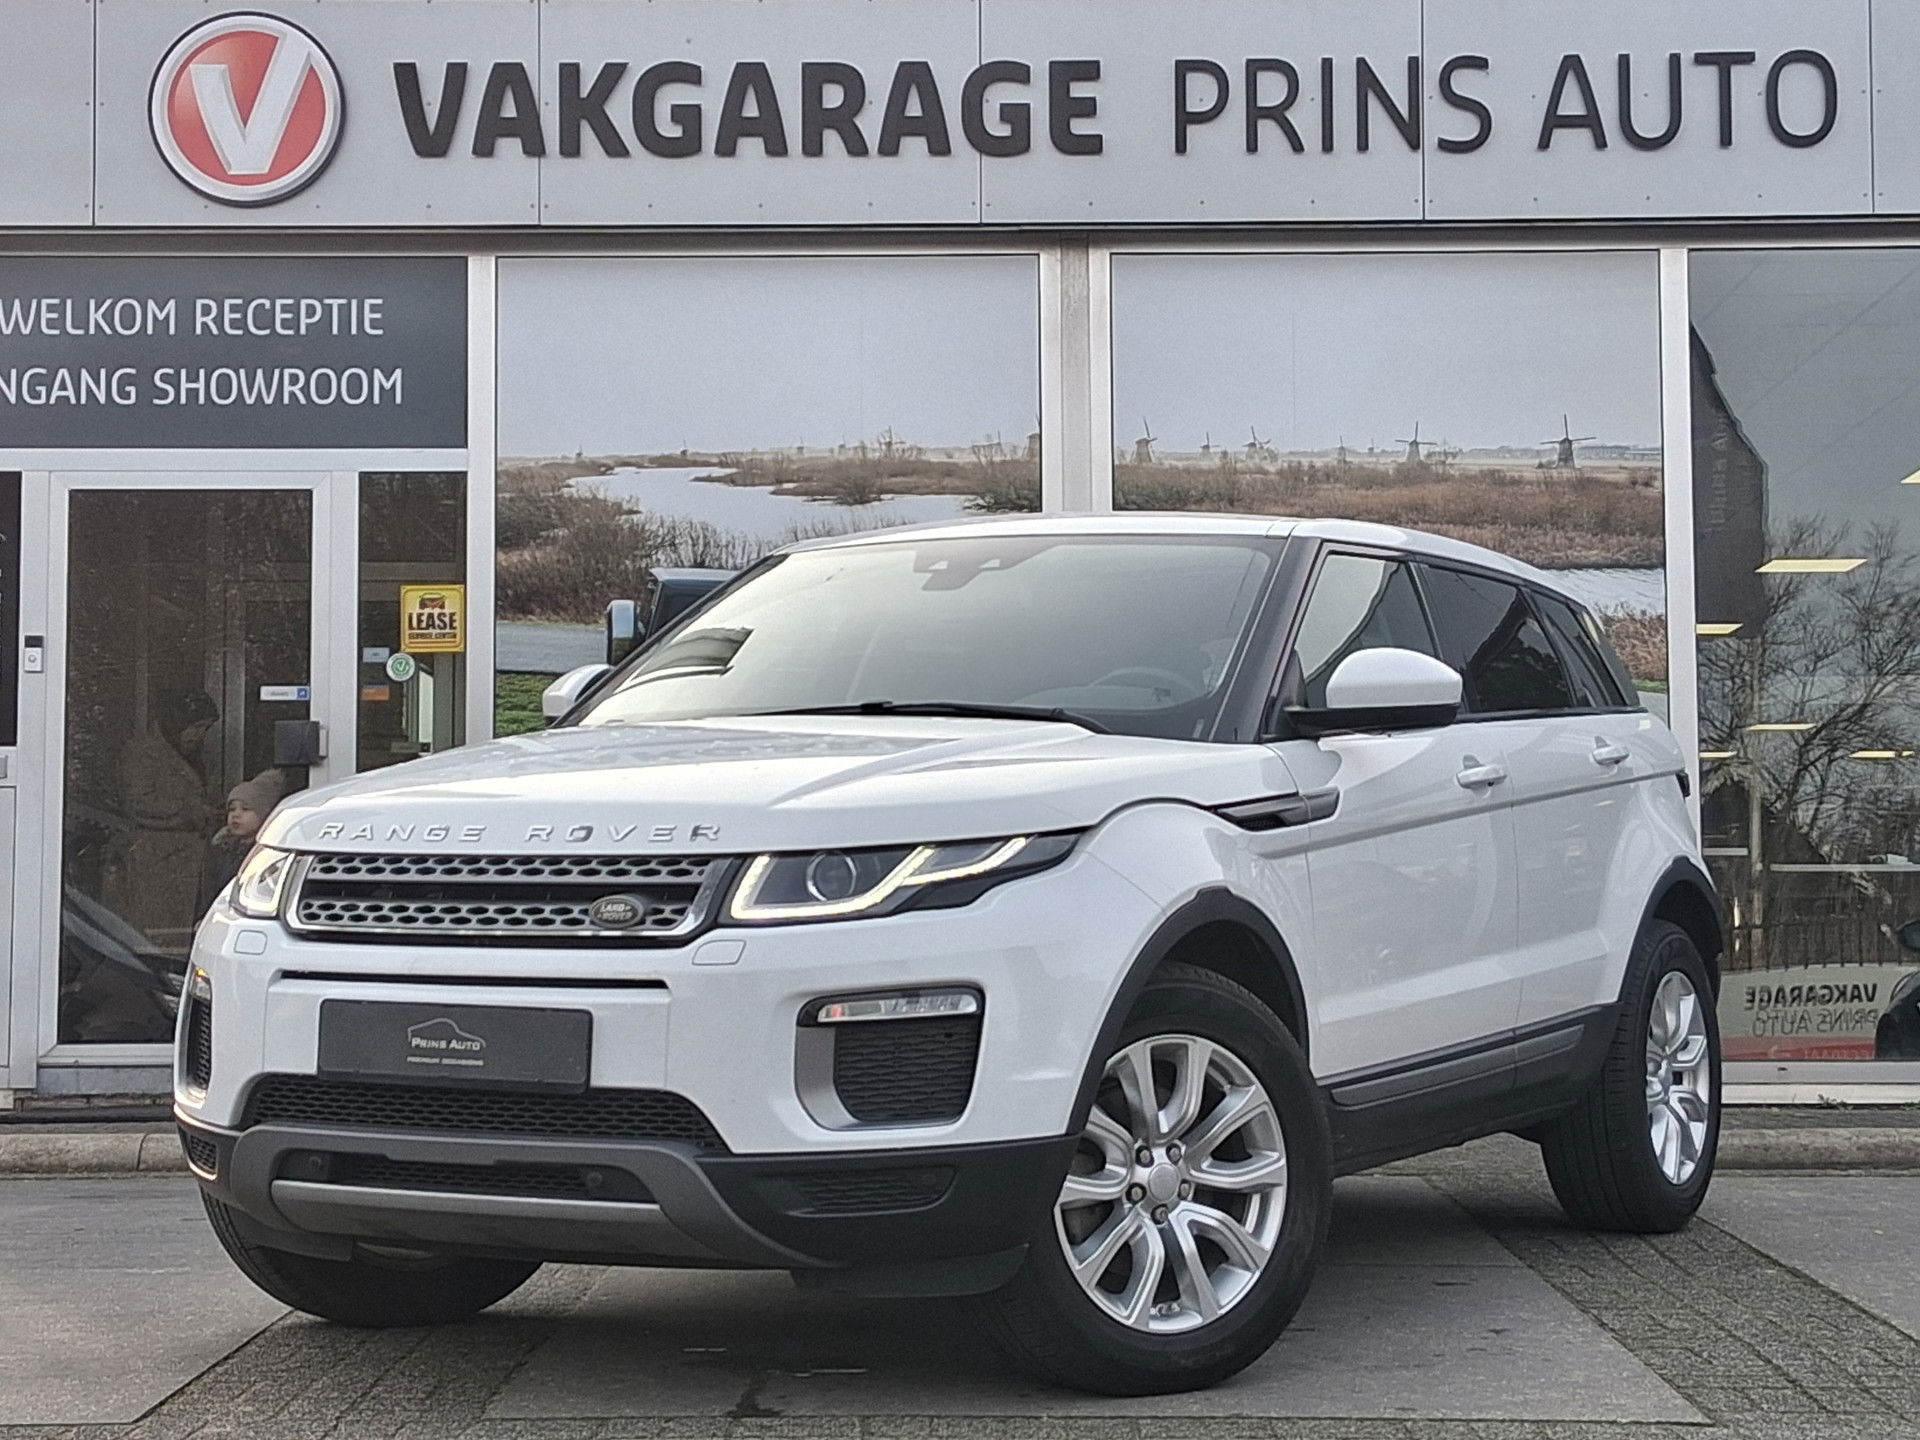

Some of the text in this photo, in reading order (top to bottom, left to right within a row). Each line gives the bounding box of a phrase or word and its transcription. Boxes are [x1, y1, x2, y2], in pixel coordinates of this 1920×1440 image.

[392, 49, 1840, 158] VAKGARAGE PRINS AUTO
[0, 298, 385, 335] WELKOM RECEPTIE
[152, 367, 403, 405] SHOWROOM
[408, 612, 457, 630] LEASE
[317, 821, 721, 843] RANGE ROVER
